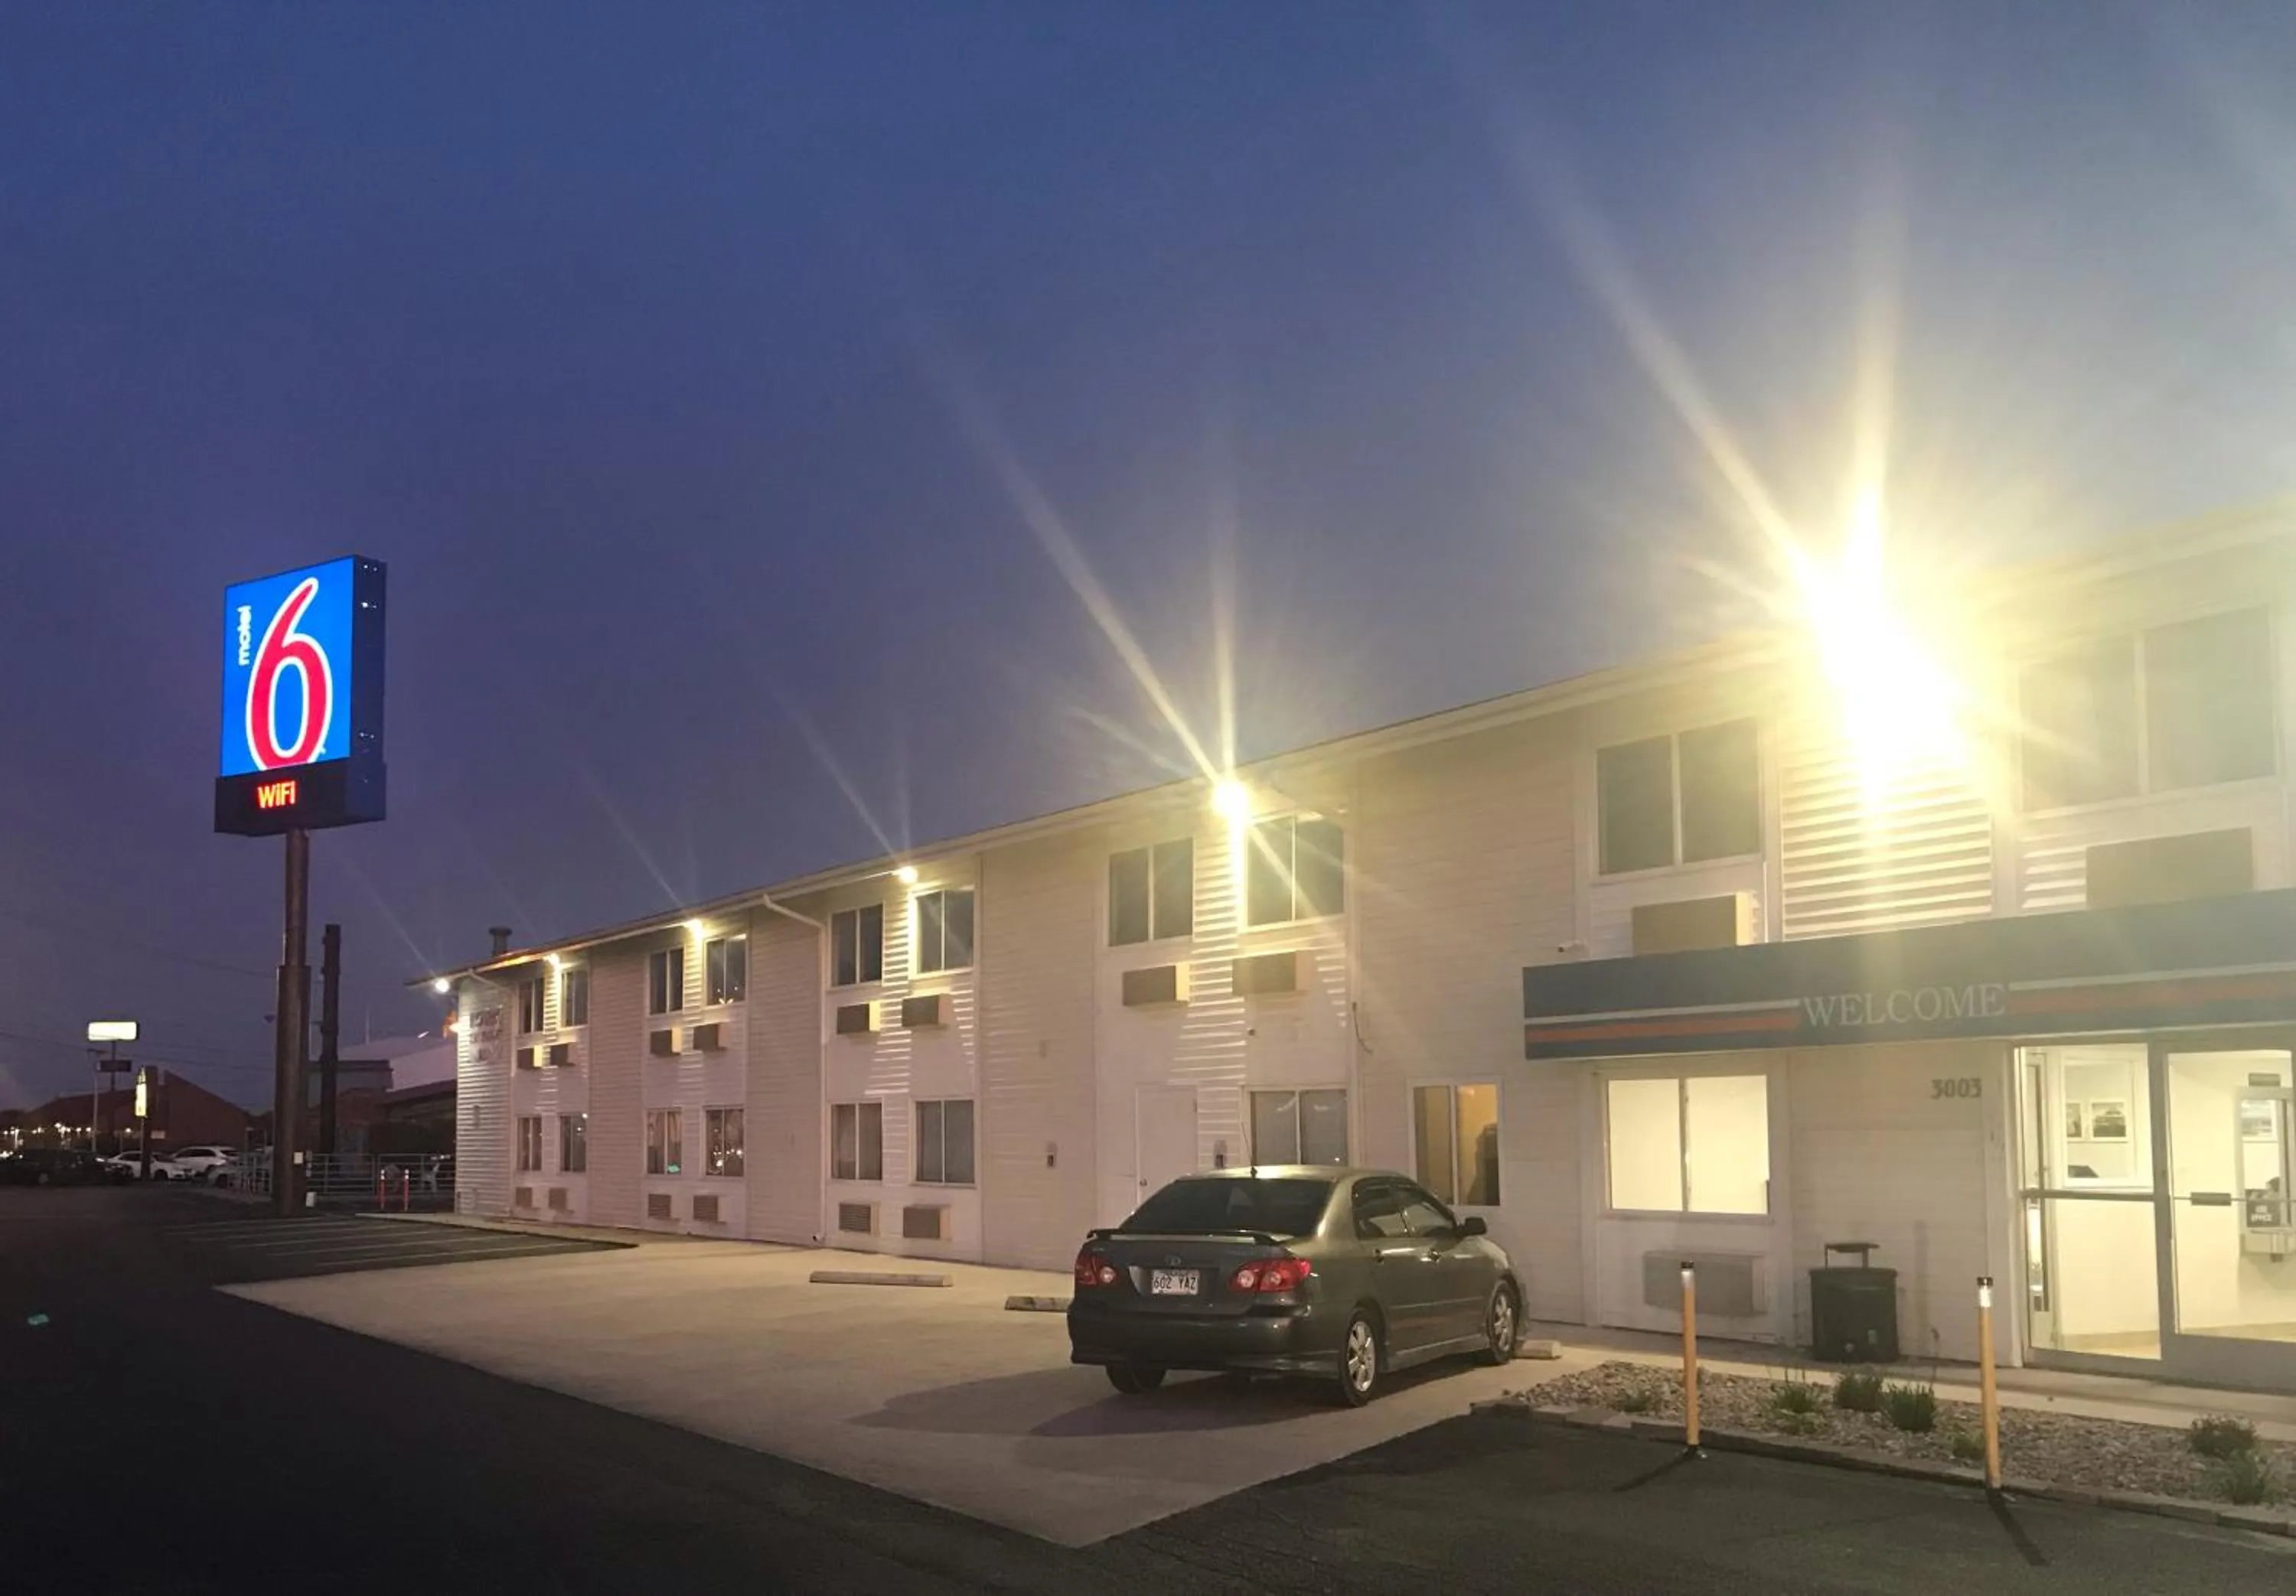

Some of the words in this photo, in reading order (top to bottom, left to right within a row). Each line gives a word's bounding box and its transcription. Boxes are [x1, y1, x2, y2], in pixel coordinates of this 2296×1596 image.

[237, 604, 252, 666] motel
[246, 577, 333, 770] 6
[1802, 982, 2006, 1027] WELCOME
[1930, 1077, 1982, 1099] 3003
[1153, 1276, 1172, 1290] 602
[1179, 1276, 1196, 1290] YAZ
